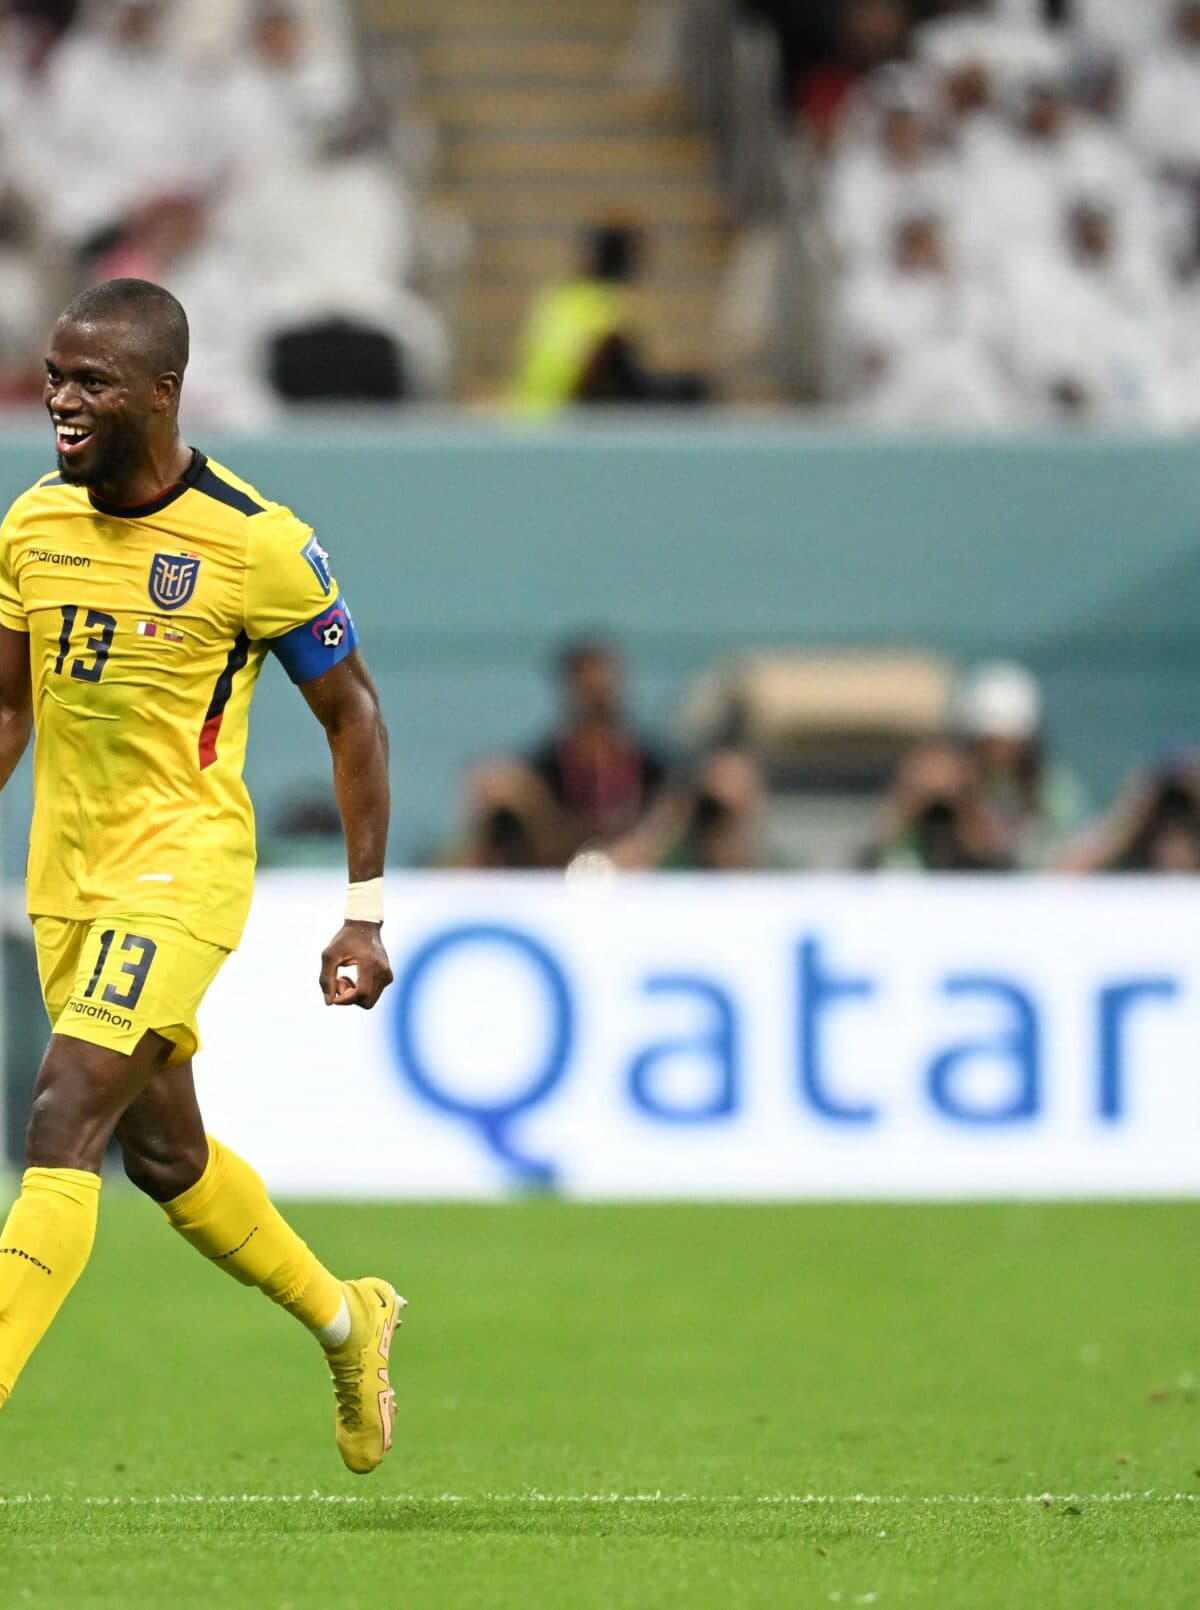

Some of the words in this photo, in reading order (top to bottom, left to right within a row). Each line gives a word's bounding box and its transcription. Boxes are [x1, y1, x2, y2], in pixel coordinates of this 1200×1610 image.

[54, 605, 118, 683] 13
[83, 929, 158, 1011] 13
[67, 1000, 133, 1031] marathon
[390, 922, 1178, 1188] Qatar
